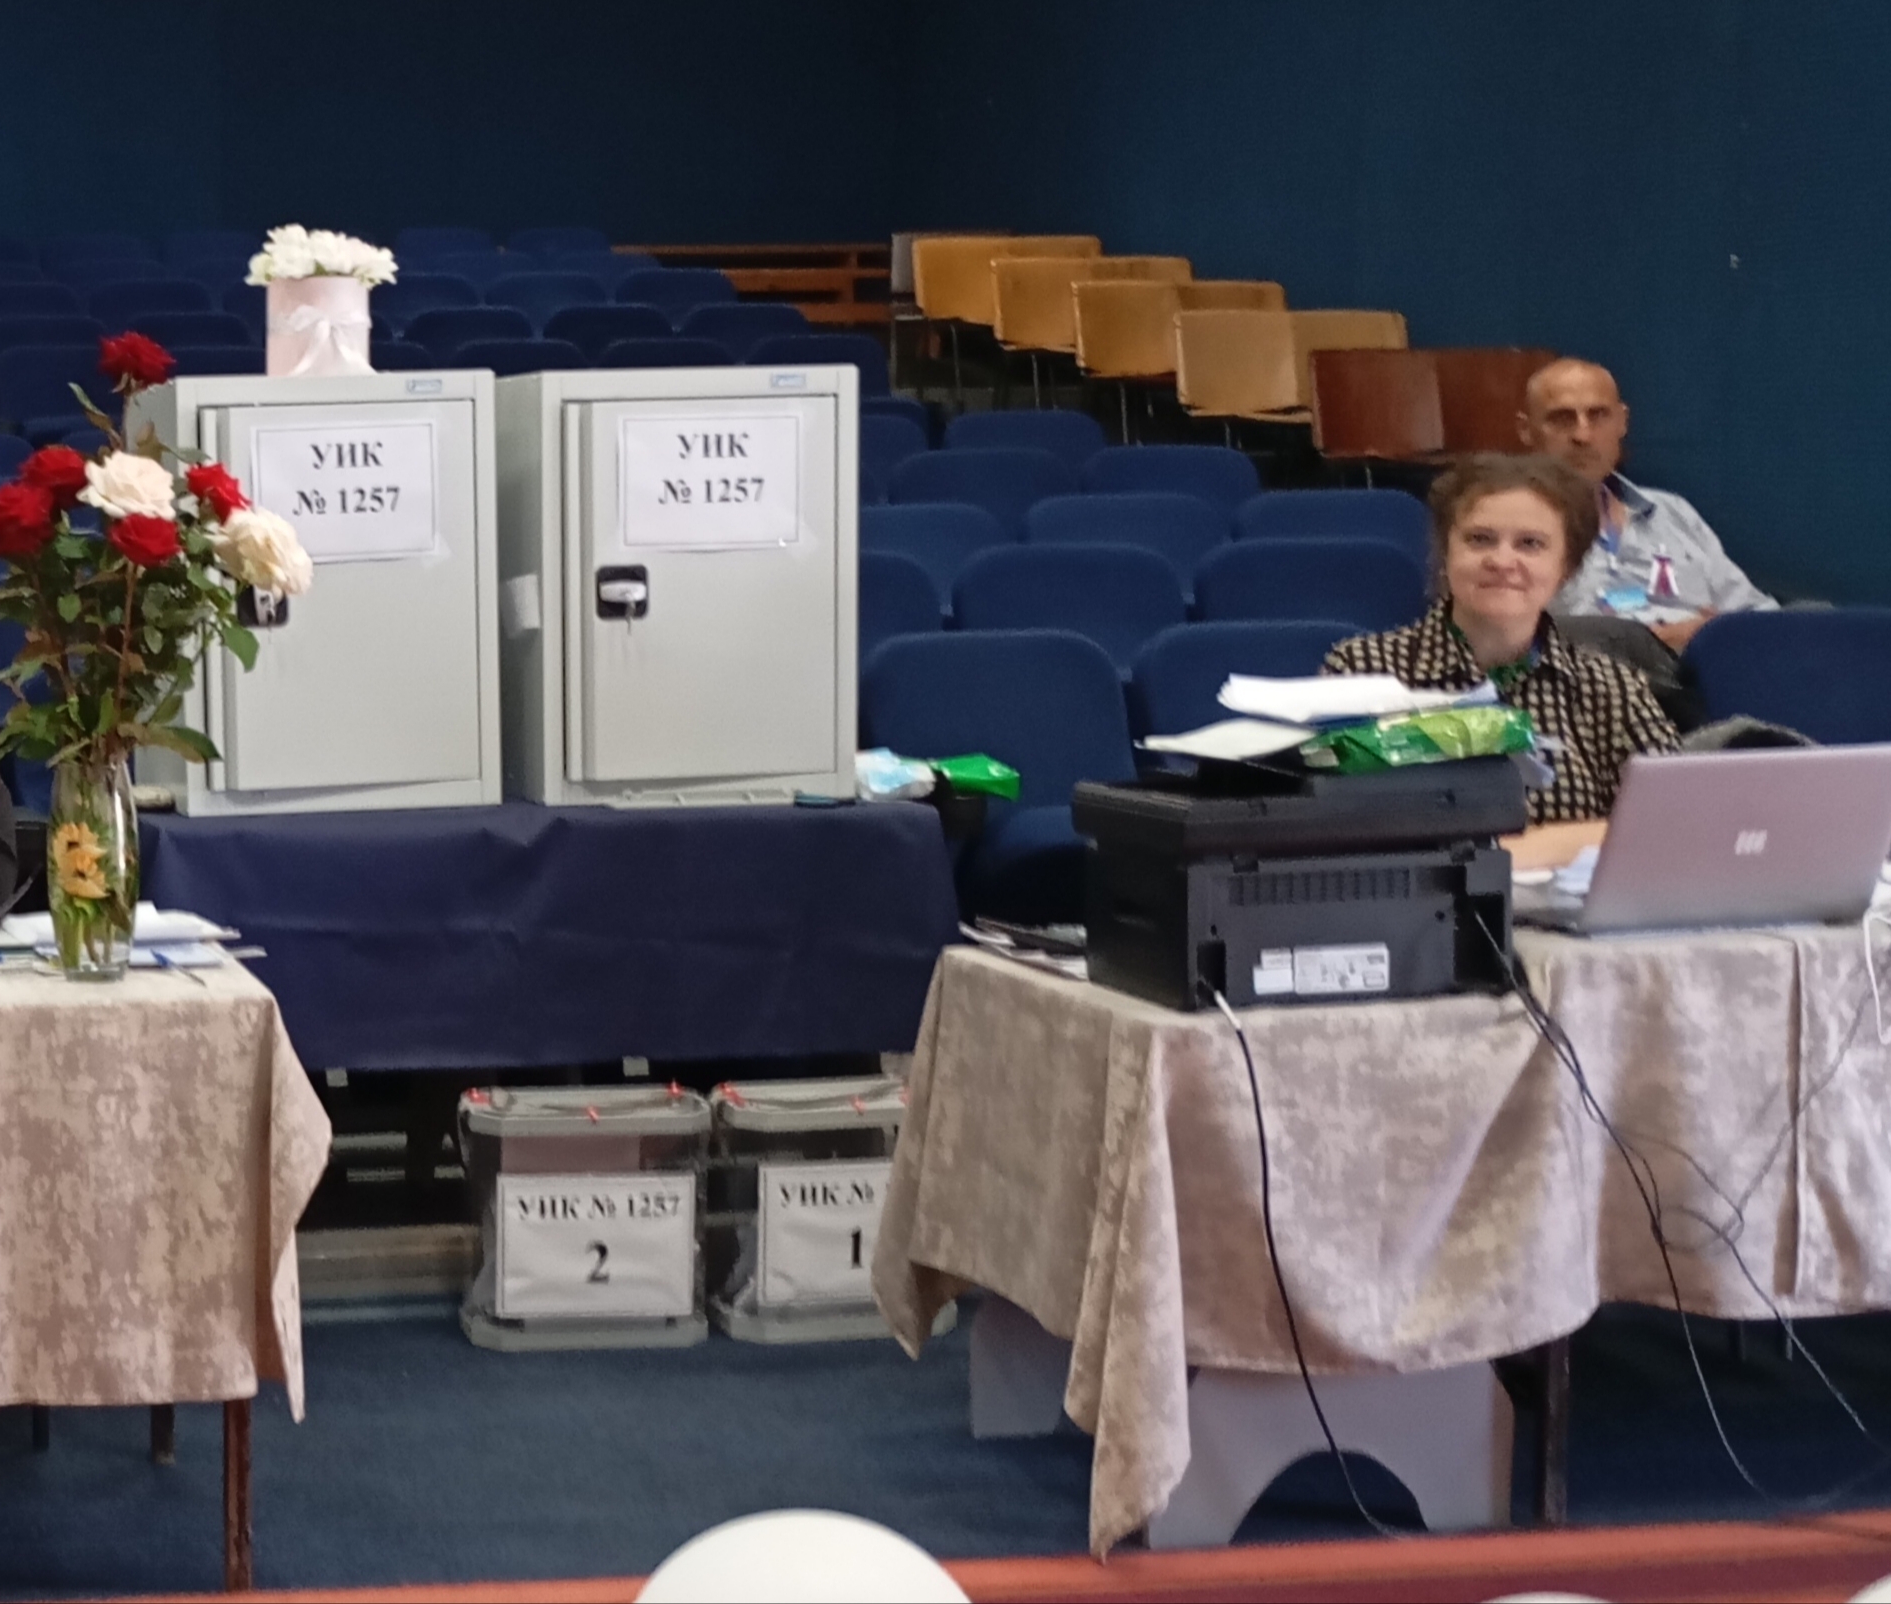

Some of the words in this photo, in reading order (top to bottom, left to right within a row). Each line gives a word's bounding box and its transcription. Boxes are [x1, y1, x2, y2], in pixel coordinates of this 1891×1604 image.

[310, 441, 383, 470] УИК
[677, 432, 749, 460] УИК
[292, 488, 327, 516] №
[338, 485, 401, 514] 1257
[657, 478, 692, 505] №
[704, 477, 765, 504] 1257
[517, 1194, 581, 1221] УИК
[627, 1191, 680, 1218] 1257
[778, 1182, 840, 1209] УИК
[584, 1239, 610, 1284] 2
[849, 1224, 865, 1270] 1
